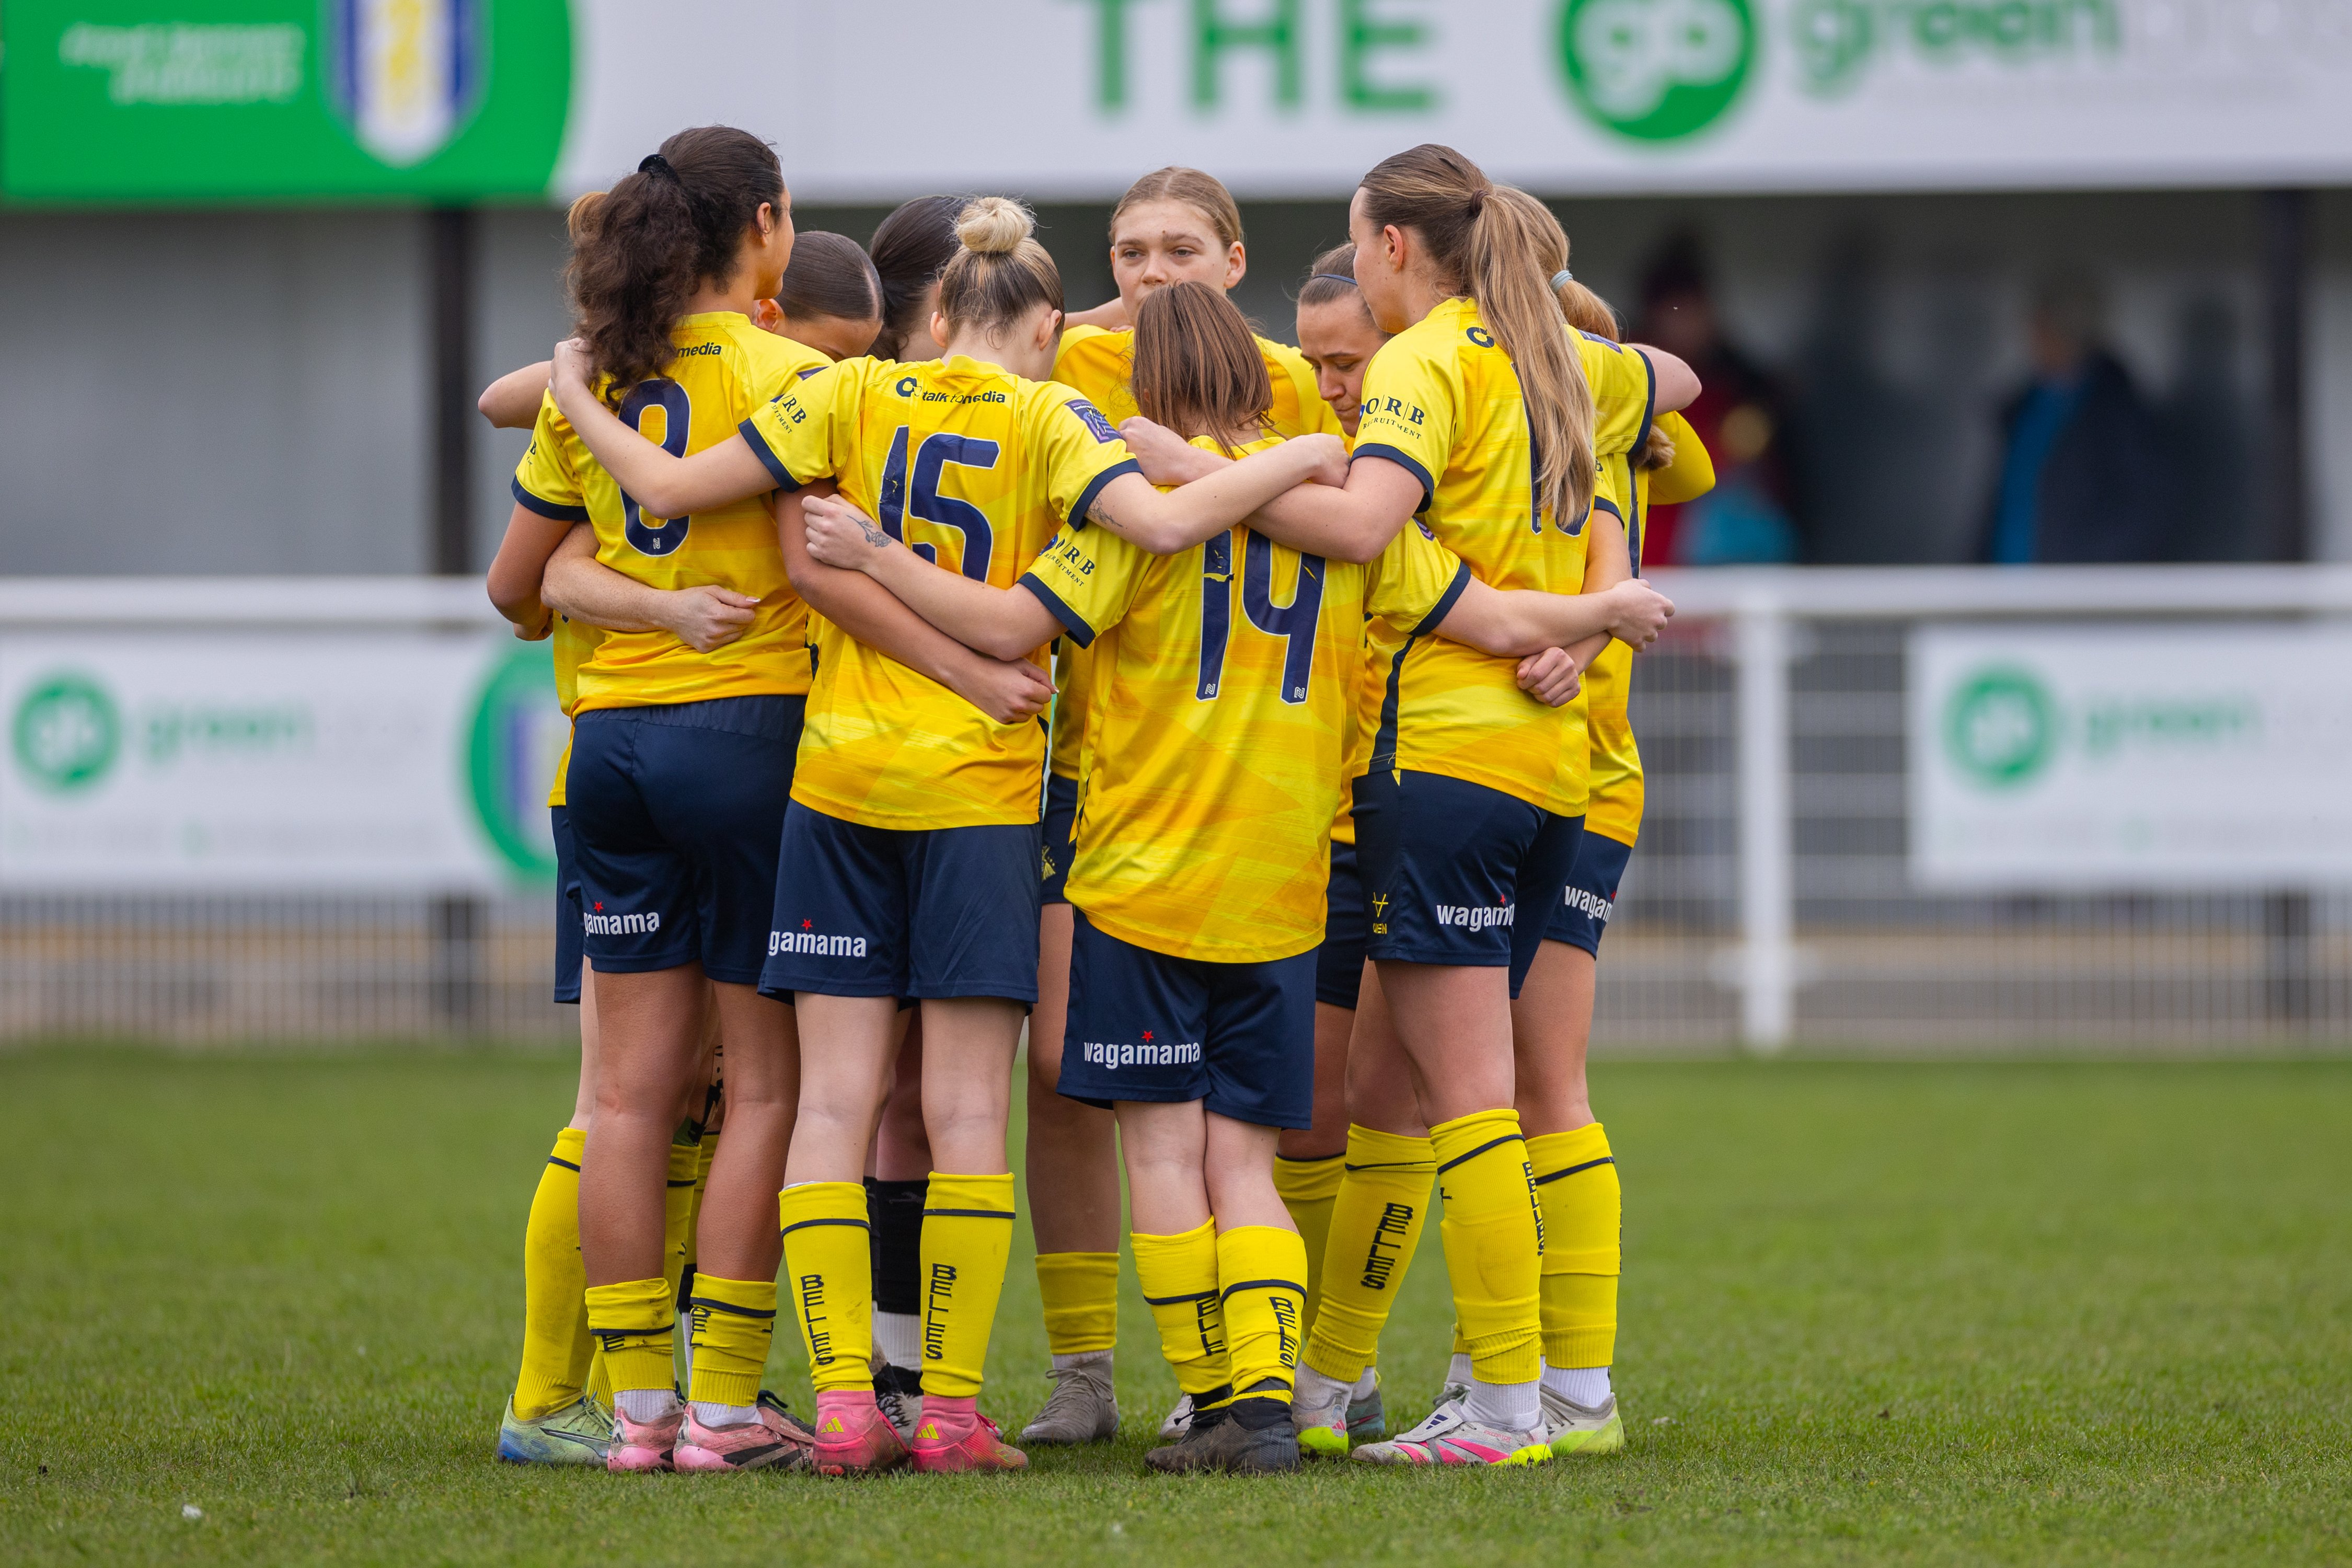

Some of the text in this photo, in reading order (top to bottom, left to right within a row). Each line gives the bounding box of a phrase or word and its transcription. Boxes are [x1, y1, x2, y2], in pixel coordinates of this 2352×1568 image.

[677, 342, 722, 358] media
[618, 378, 691, 557] 8
[879, 425, 1000, 584] 15
[768, 931, 867, 957] gamama
[1083, 1042, 1201, 1069] wagamama
[1361, 1202, 1413, 1289] BELLES
[801, 1274, 835, 1366] BELLES
[926, 1263, 957, 1360] BELLES
[780, 1424, 806, 1437] BECKHAM
